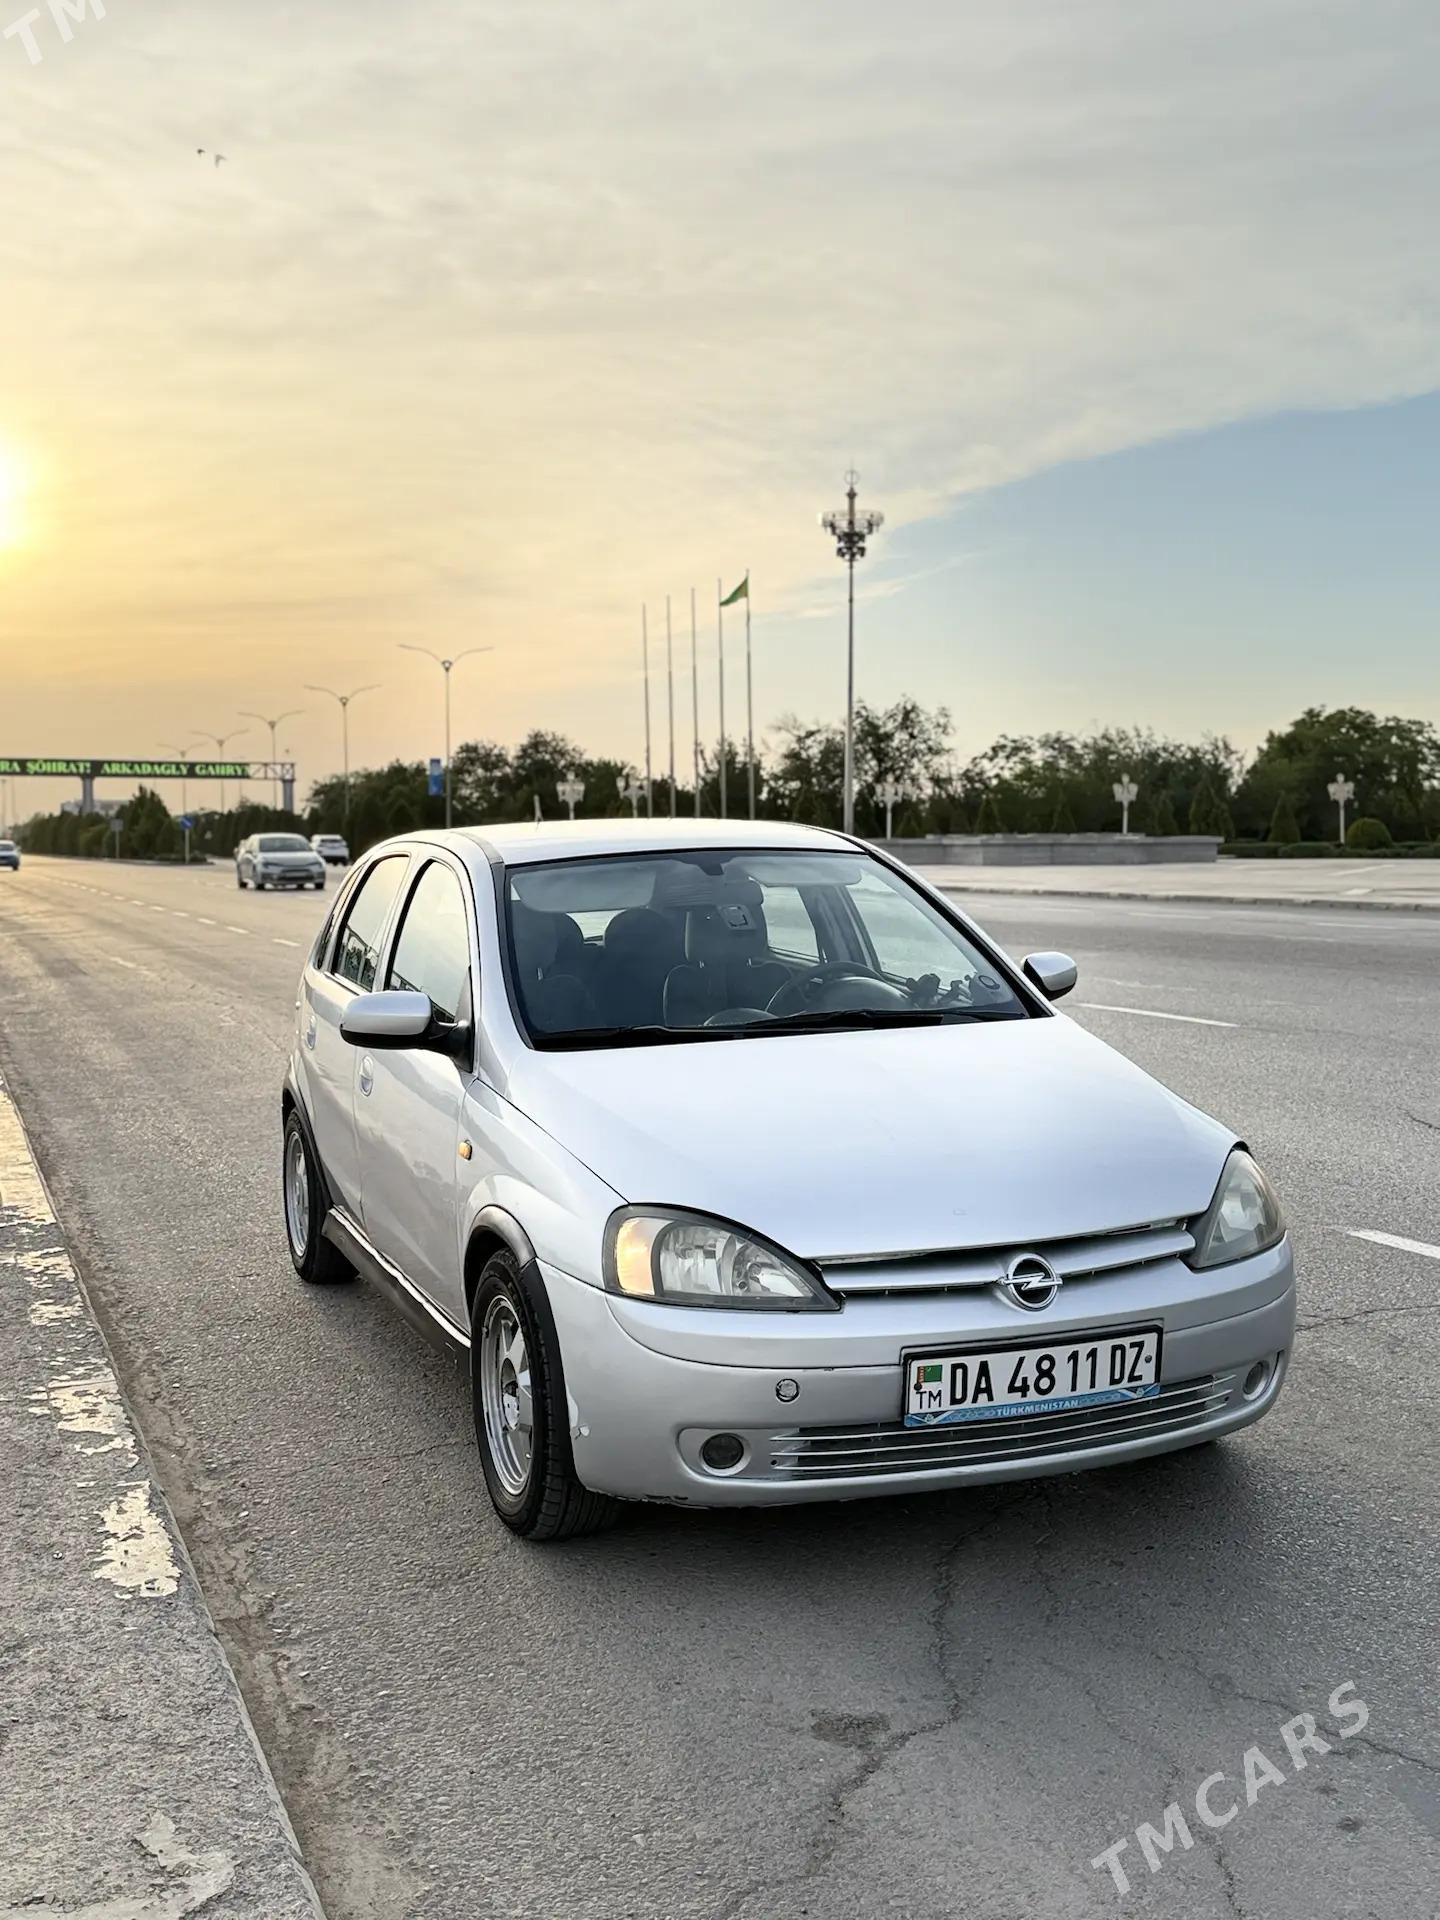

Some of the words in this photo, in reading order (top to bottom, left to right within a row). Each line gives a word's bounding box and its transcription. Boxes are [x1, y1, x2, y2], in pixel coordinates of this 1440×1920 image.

[101, 762, 189, 776] ARKADAGLY
[950, 1361, 994, 1405] DA
[1007, 1354, 1056, 1398] 48
[1067, 1347, 1098, 1392] 11
[1109, 1340, 1145, 1385] DZ
[916, 1389, 942, 1409] TM
